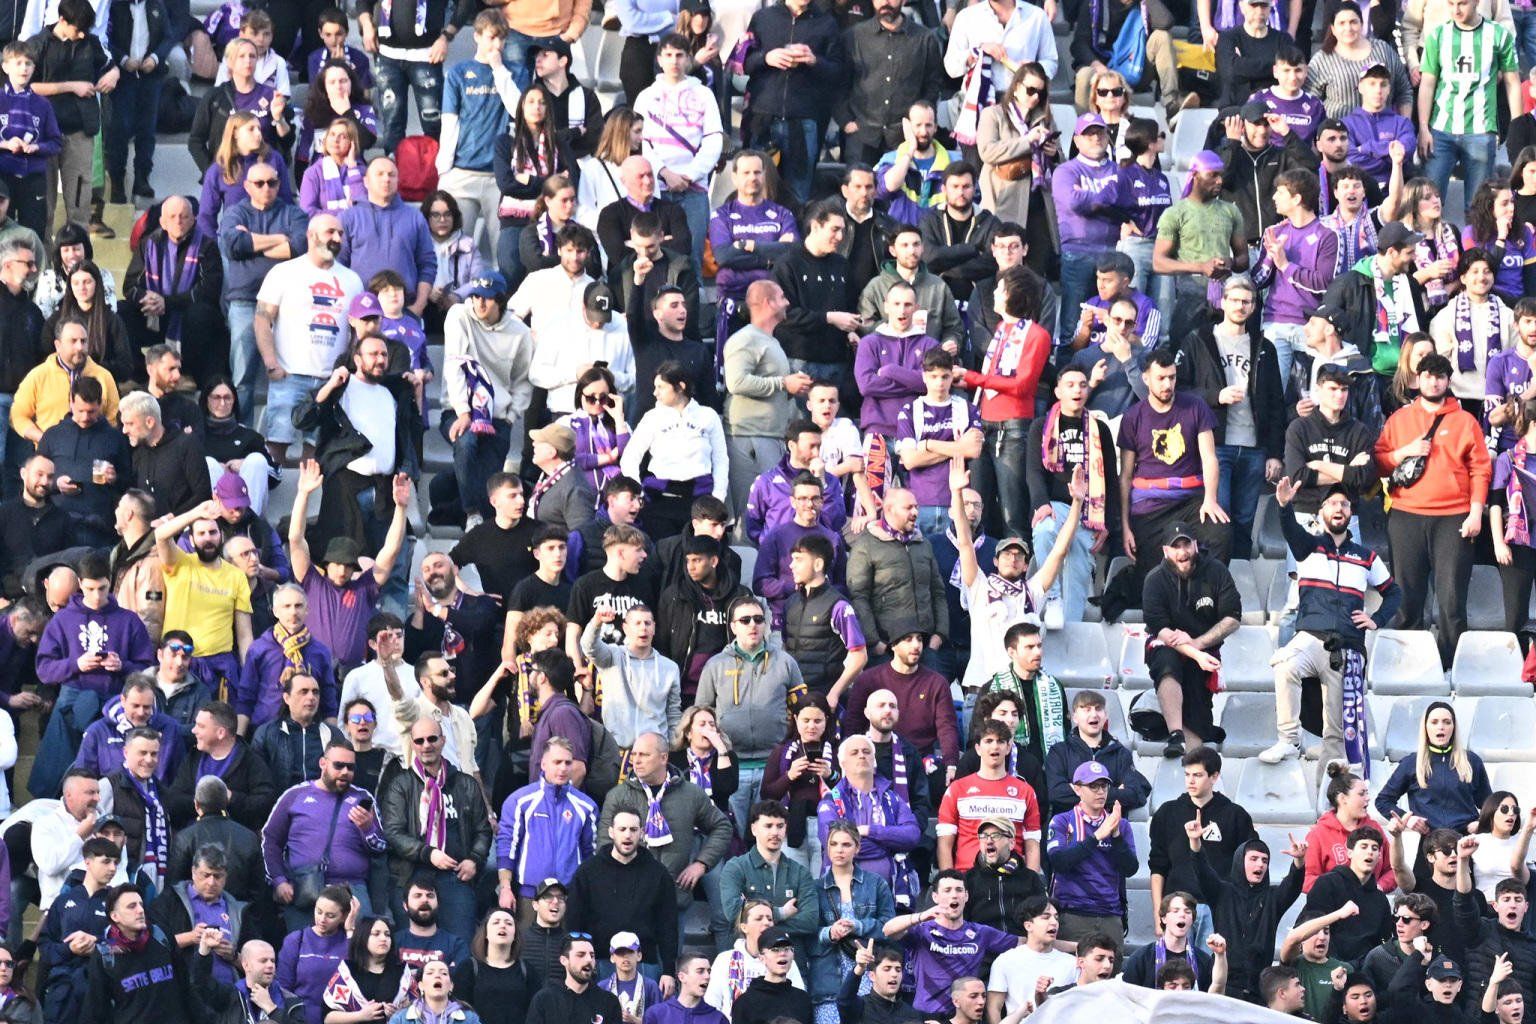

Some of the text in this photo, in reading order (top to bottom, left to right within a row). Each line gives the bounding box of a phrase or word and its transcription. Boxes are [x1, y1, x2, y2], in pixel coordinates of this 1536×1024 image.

[1457, 56, 1473, 73] fi
[1219, 354, 1251, 372] OFFE
[968, 804, 1017, 816] Mediacom
[930, 942, 979, 956] Mediacom
